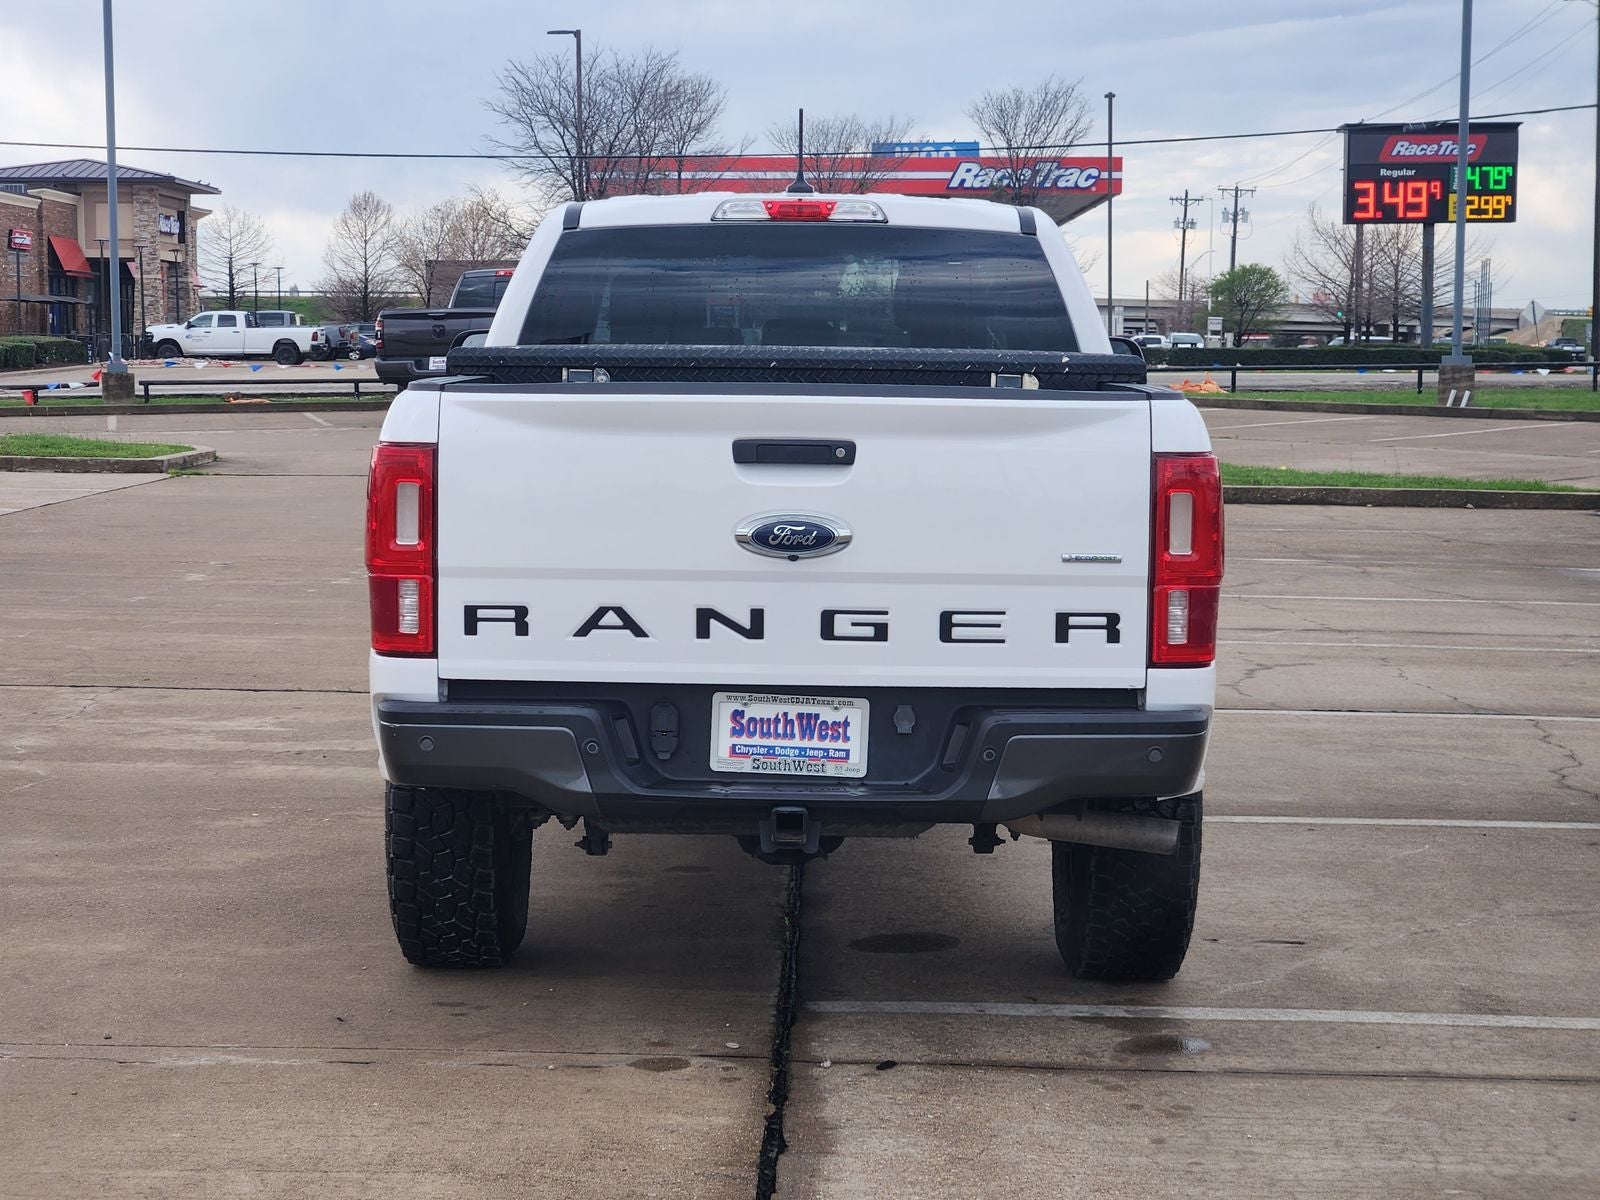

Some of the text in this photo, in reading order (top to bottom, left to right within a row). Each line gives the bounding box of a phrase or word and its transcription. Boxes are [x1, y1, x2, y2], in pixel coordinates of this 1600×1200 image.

[947, 161, 1102, 190] RaceTrac
[1380, 168, 1416, 177] Regular
[768, 524, 818, 546] Ford
[463, 604, 1121, 644] RANGER
[726, 694, 854, 707] www.SouthWestCDJRTexas.com
[730, 708, 851, 743] SouthWest
[735, 745, 846, 758] Chrysler Dodge Jeep Ram
[752, 758, 827, 773] SouthWest
